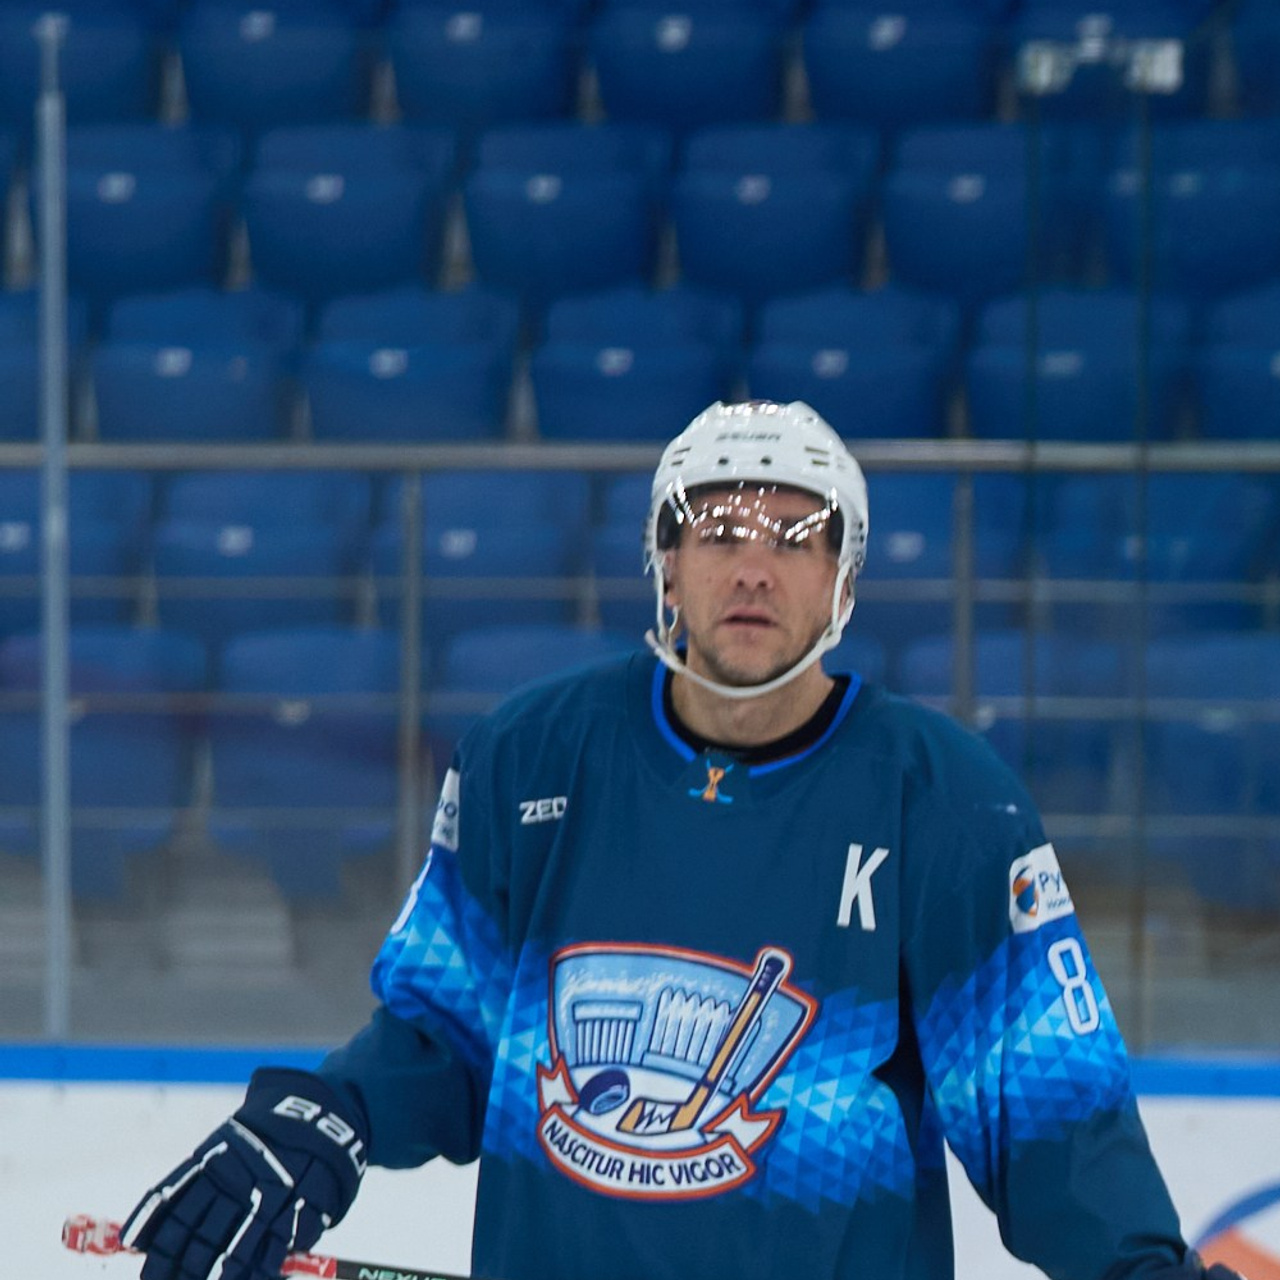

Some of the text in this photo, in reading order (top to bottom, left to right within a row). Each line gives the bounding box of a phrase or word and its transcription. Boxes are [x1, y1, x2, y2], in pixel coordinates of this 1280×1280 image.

[1047, 937, 1100, 1036] 8
[544, 1119, 741, 1186] NASCITUR HIC VIGOR
